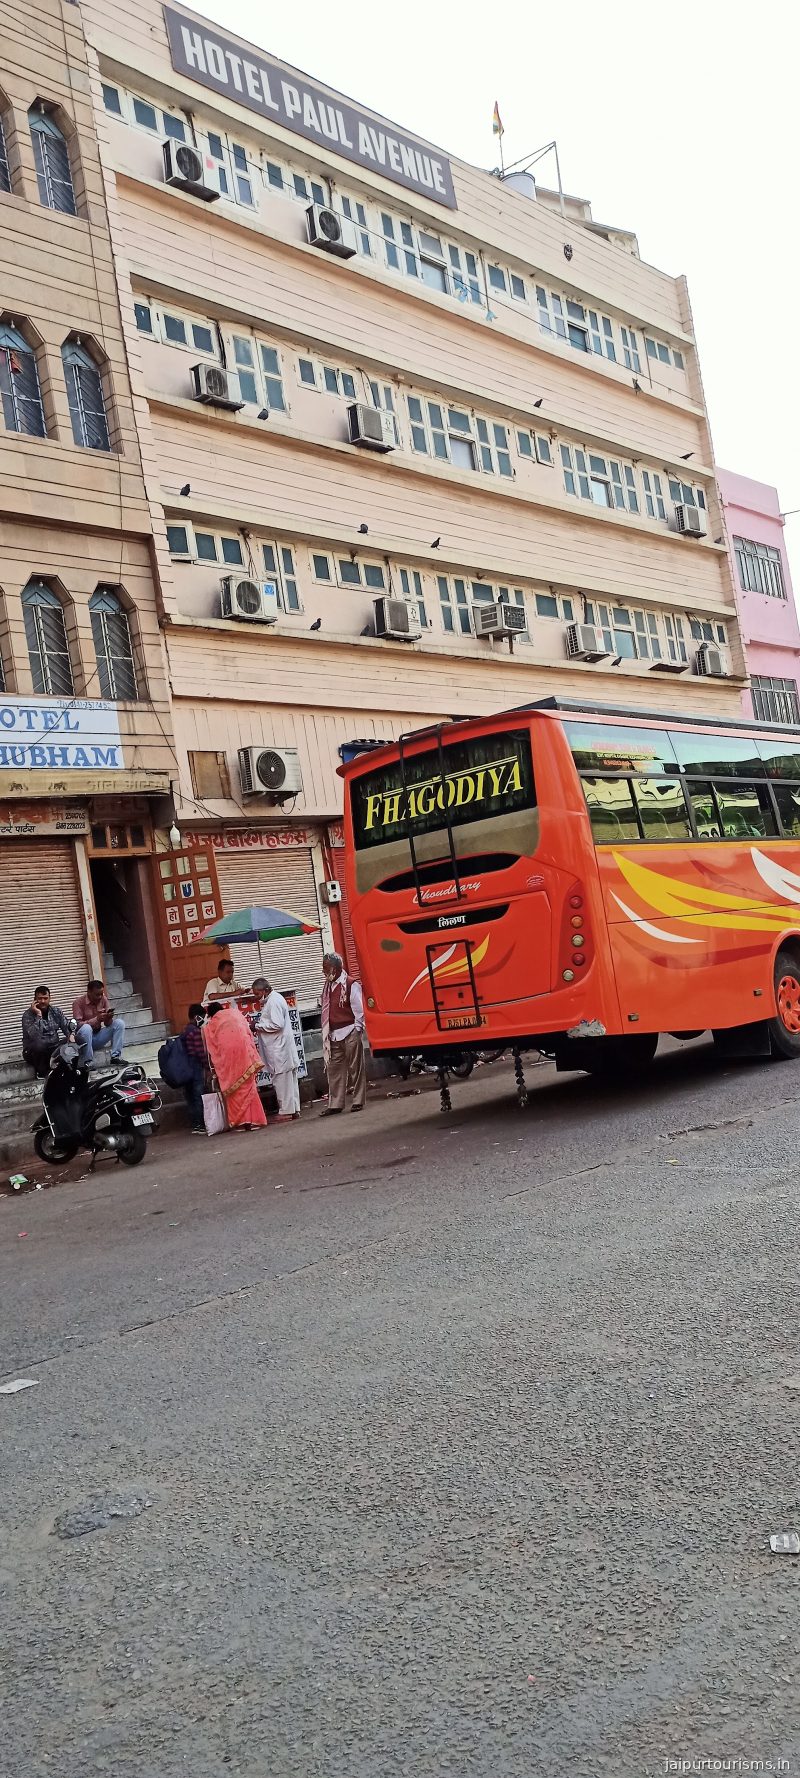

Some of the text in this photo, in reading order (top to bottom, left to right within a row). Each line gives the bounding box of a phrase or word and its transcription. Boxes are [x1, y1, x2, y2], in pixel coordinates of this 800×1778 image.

[180, 25, 447, 195] HOTEL PAUL AVENUE
[0, 708, 79, 730] OTEL
[364, 760, 524, 830] FHAGODIYA
[412, 881, 482, 904] Choudhary
